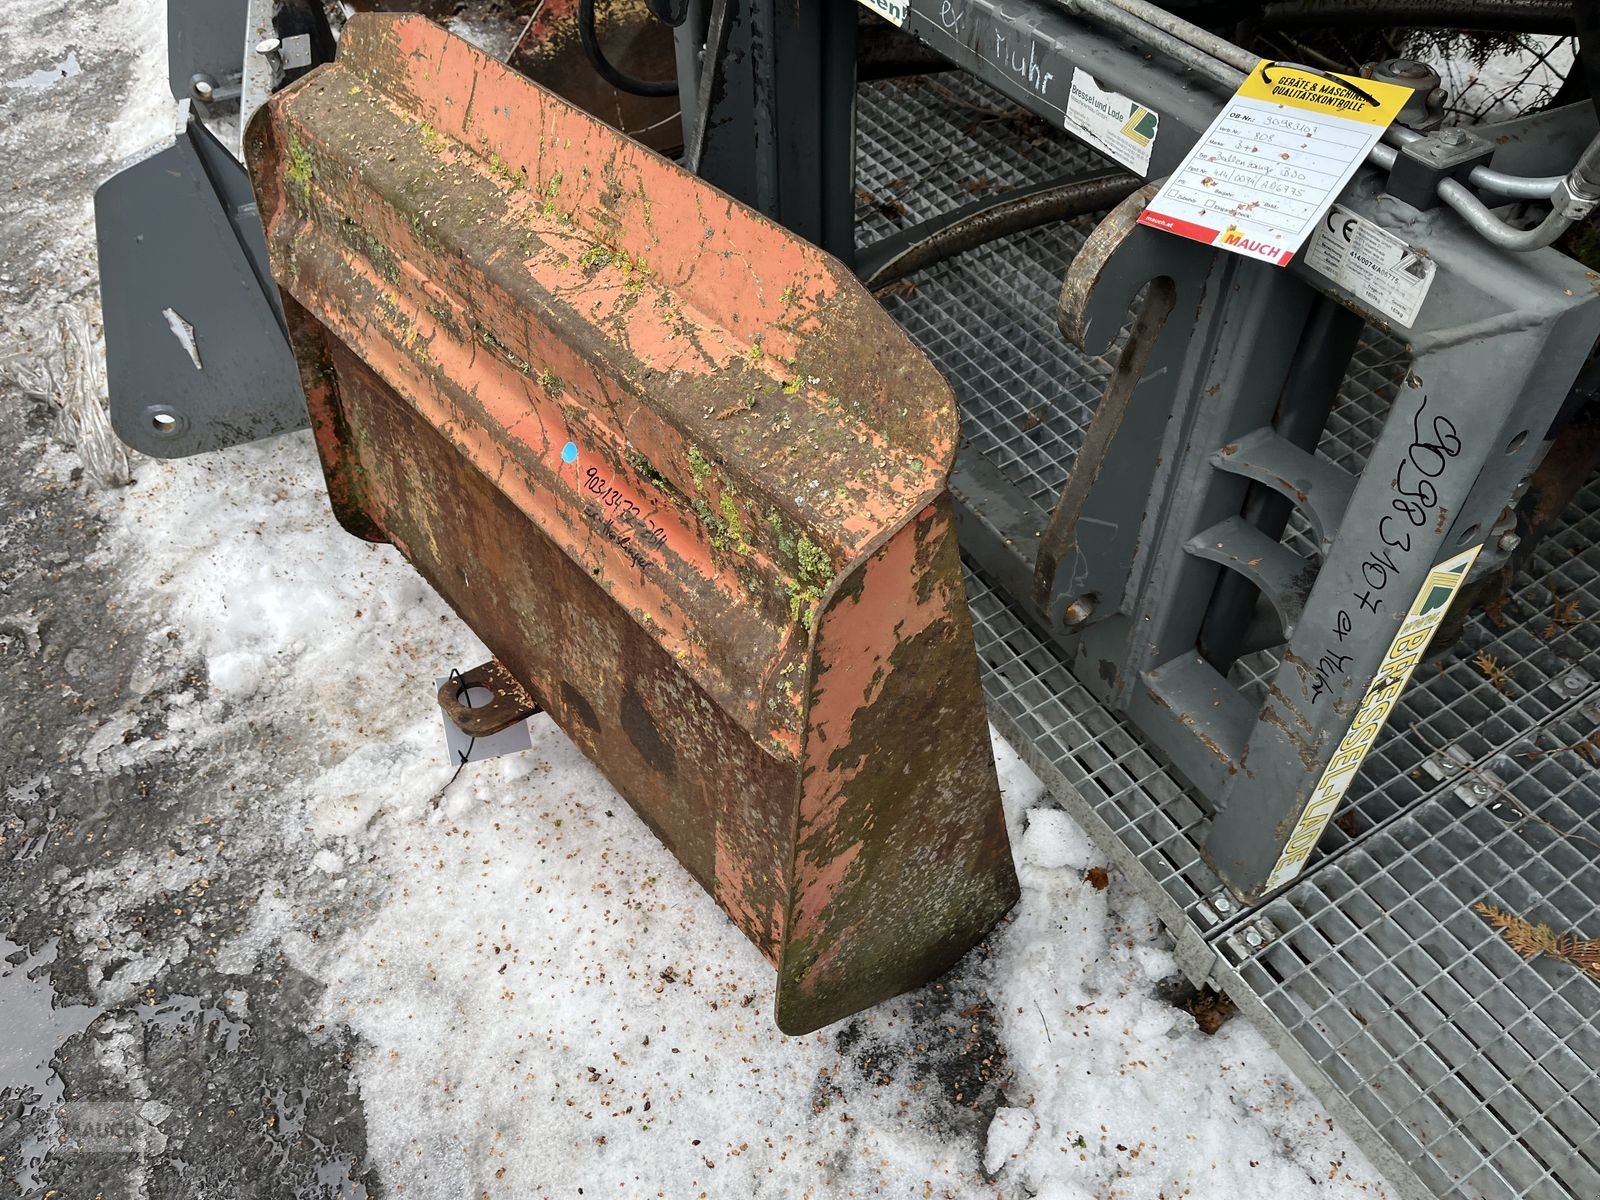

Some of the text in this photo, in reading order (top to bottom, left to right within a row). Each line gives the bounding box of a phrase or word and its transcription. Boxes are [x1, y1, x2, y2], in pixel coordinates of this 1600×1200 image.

[1278, 76, 1309, 90] GERÄTE
[1310, 83, 1318, 91] &
[1072, 85, 1095, 104] Bressel
[1095, 101, 1107, 113] und
[1272, 85, 1365, 112] QUALITÄTSKONTROLLE
[1228, 111, 1256, 122] OB-Nr.:
[1225, 234, 1281, 257] MAUCH
